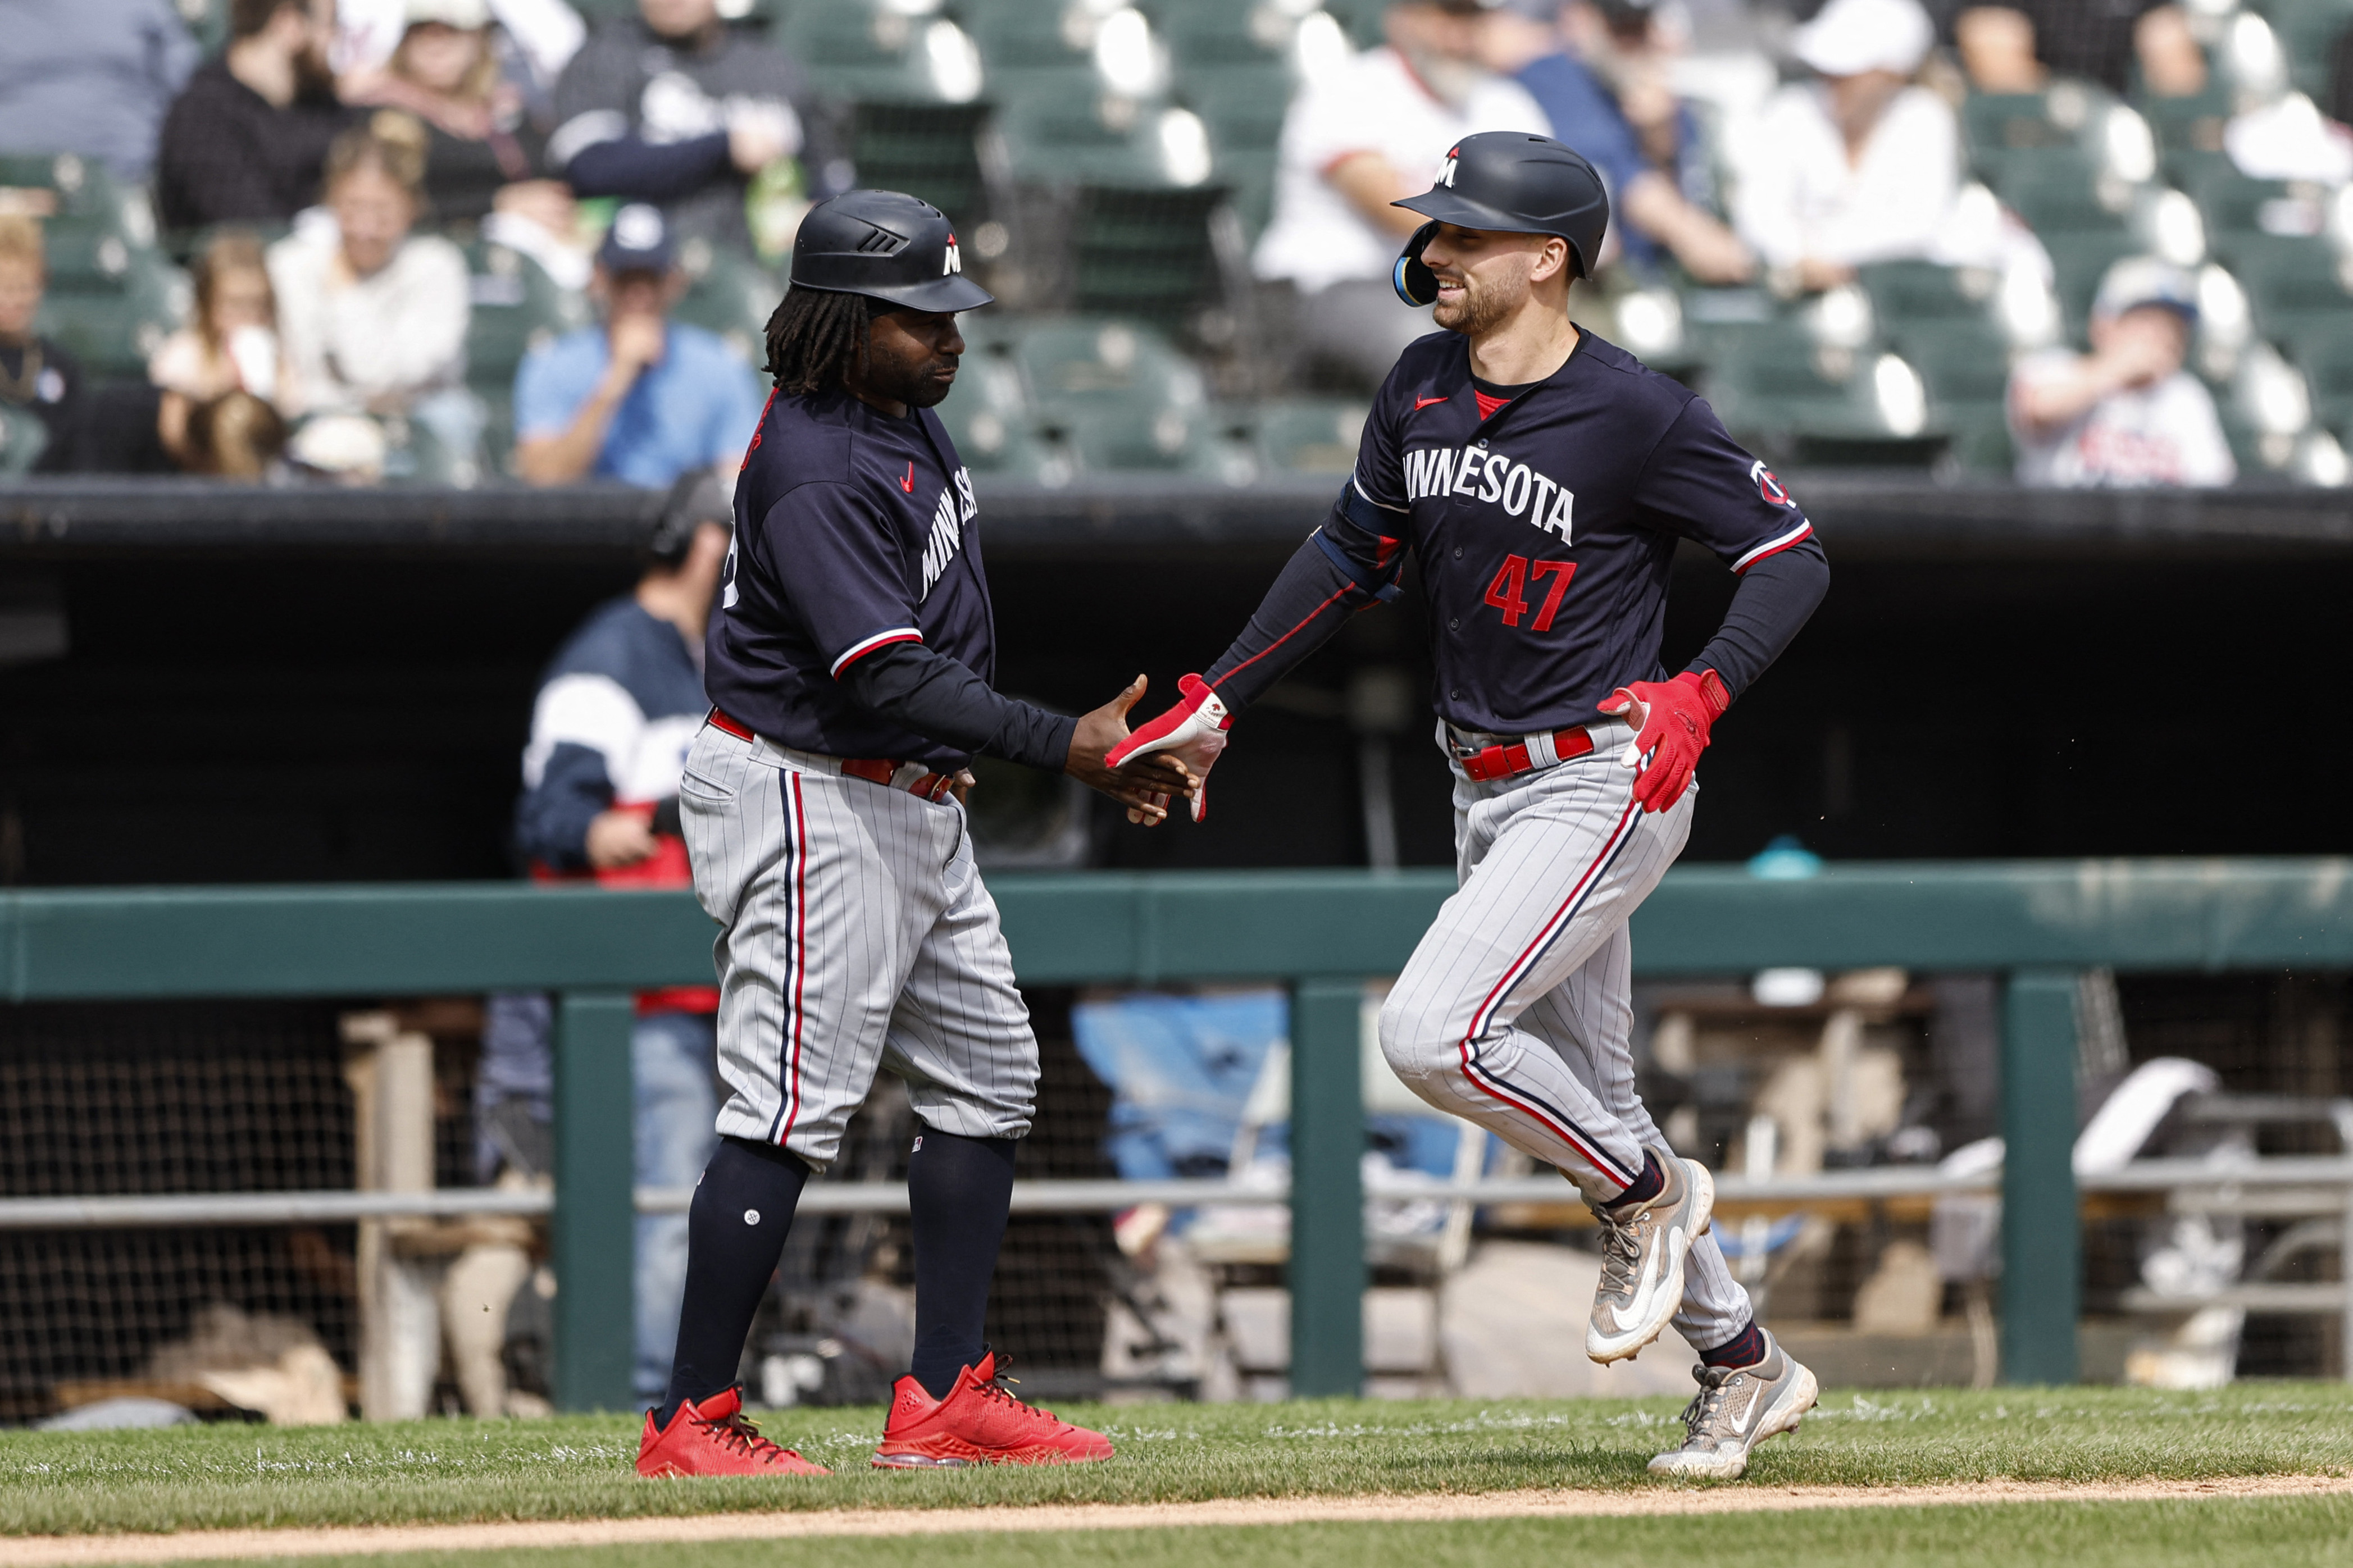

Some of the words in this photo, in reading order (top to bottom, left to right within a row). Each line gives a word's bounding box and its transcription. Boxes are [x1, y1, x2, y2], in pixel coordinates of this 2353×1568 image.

[1435, 157, 1459, 188] M
[943, 244, 962, 276] M
[1403, 444, 1574, 548] INNESOTA
[1485, 553, 1577, 632] 47
